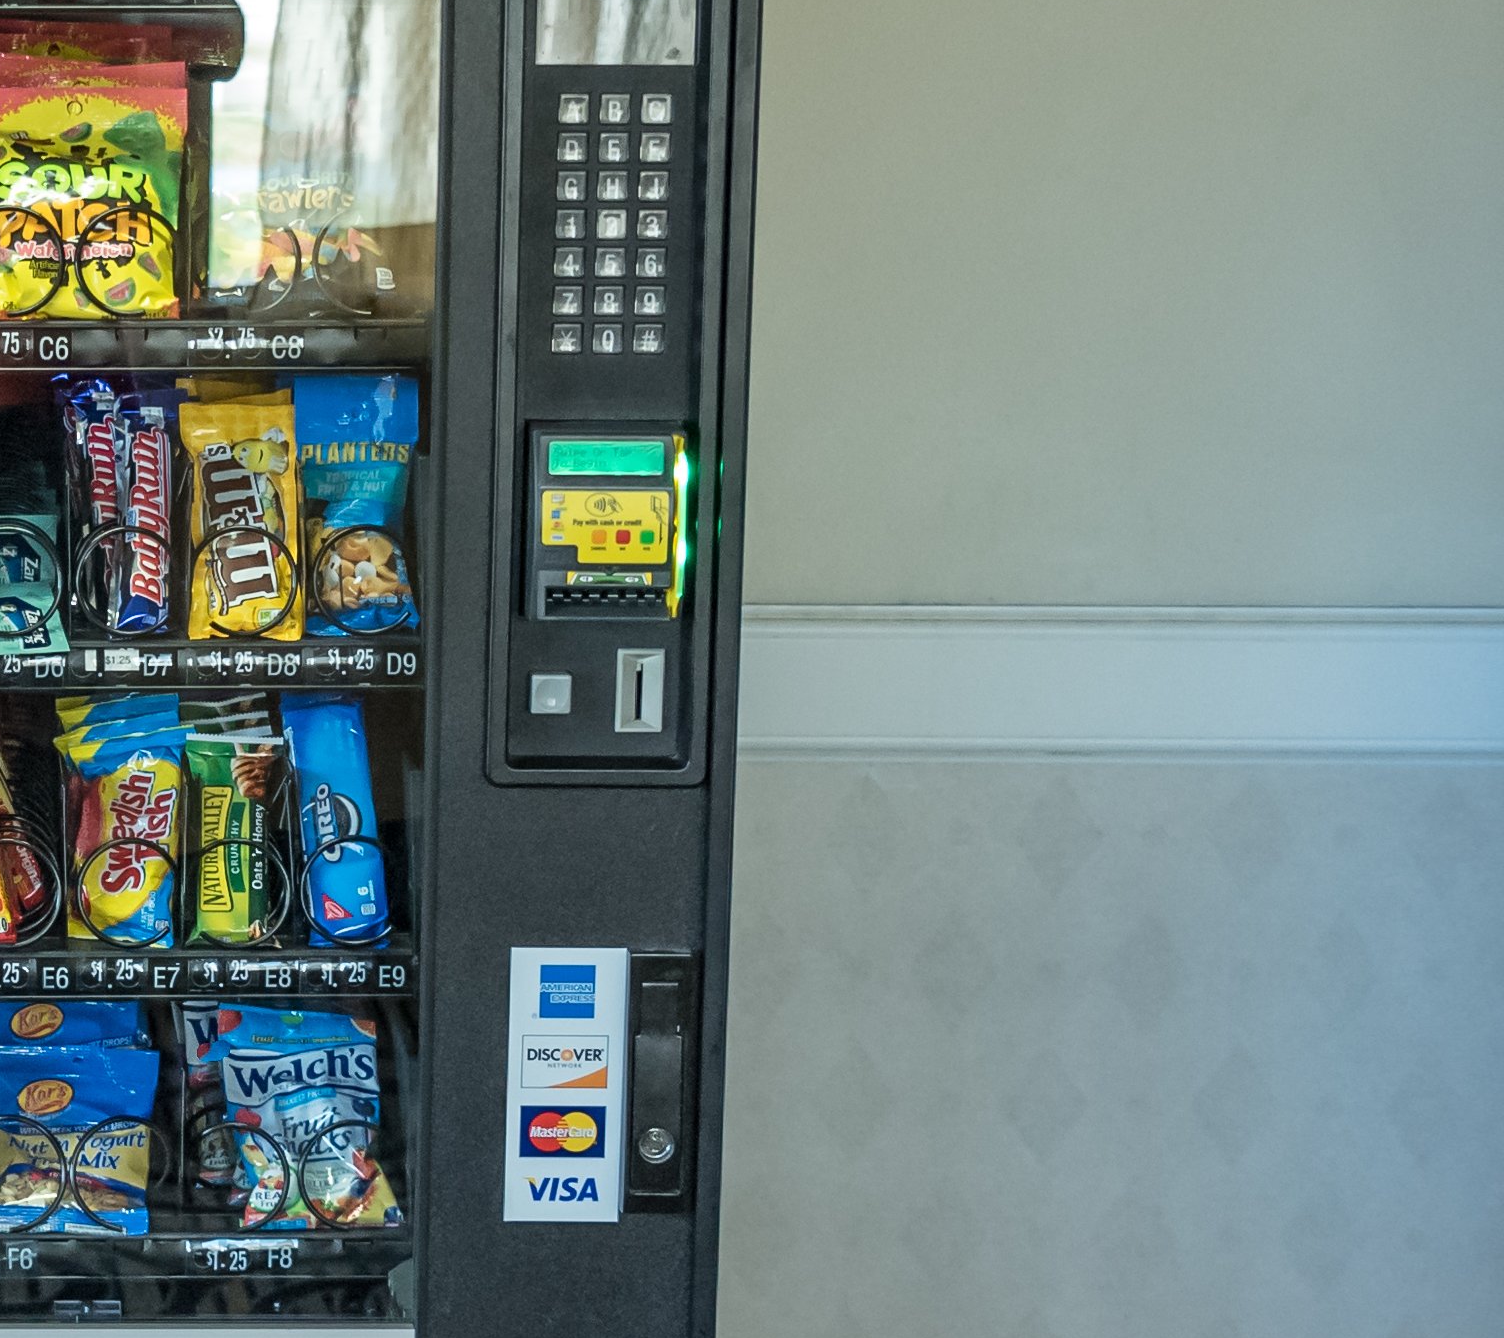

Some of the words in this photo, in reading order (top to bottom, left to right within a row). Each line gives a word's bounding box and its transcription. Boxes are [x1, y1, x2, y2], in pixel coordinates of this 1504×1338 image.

[39, 336, 69, 360] C6
[272, 334, 301, 360] C8
[300, 441, 410, 464] PLANTERS
[361, 480, 386, 492] NUT
[105, 655, 132, 666] $1.25
[268, 655, 297, 676] D8
[387, 654, 416, 675] D9
[203, 789, 227, 846] VALLEY
[251, 804, 265, 843] Honey
[316, 783, 342, 863] OREO
[101, 770, 156, 894] Swedish
[230, 818, 241, 875] CRUNHY
[203, 848, 227, 907] NATURE
[251, 861, 264, 890] Oats
[43, 968, 69, 988] E6
[154, 967, 180, 988] E7
[265, 967, 292, 987] E8
[379, 966, 406, 987] E9
[540, 983, 592, 992] AMERICAN
[551, 994, 596, 1003] EXPRESS
[527, 1048, 603, 1062] DISCOVER
[229, 1047, 375, 1098] Welch's
[25, 1084, 67, 1103] Kar's
[281, 1106, 338, 1139] Fruit
[530, 1125, 596, 1140] MasterCard
[10, 1137, 49, 1154] Nut
[75, 1132, 146, 1153] Yogurt
[79, 1151, 120, 1170] Mix
[523, 1176, 599, 1202] VISA
[8, 1248, 34, 1270] F6
[207, 1249, 248, 1271] $1.25
[268, 1248, 292, 1268] F8
